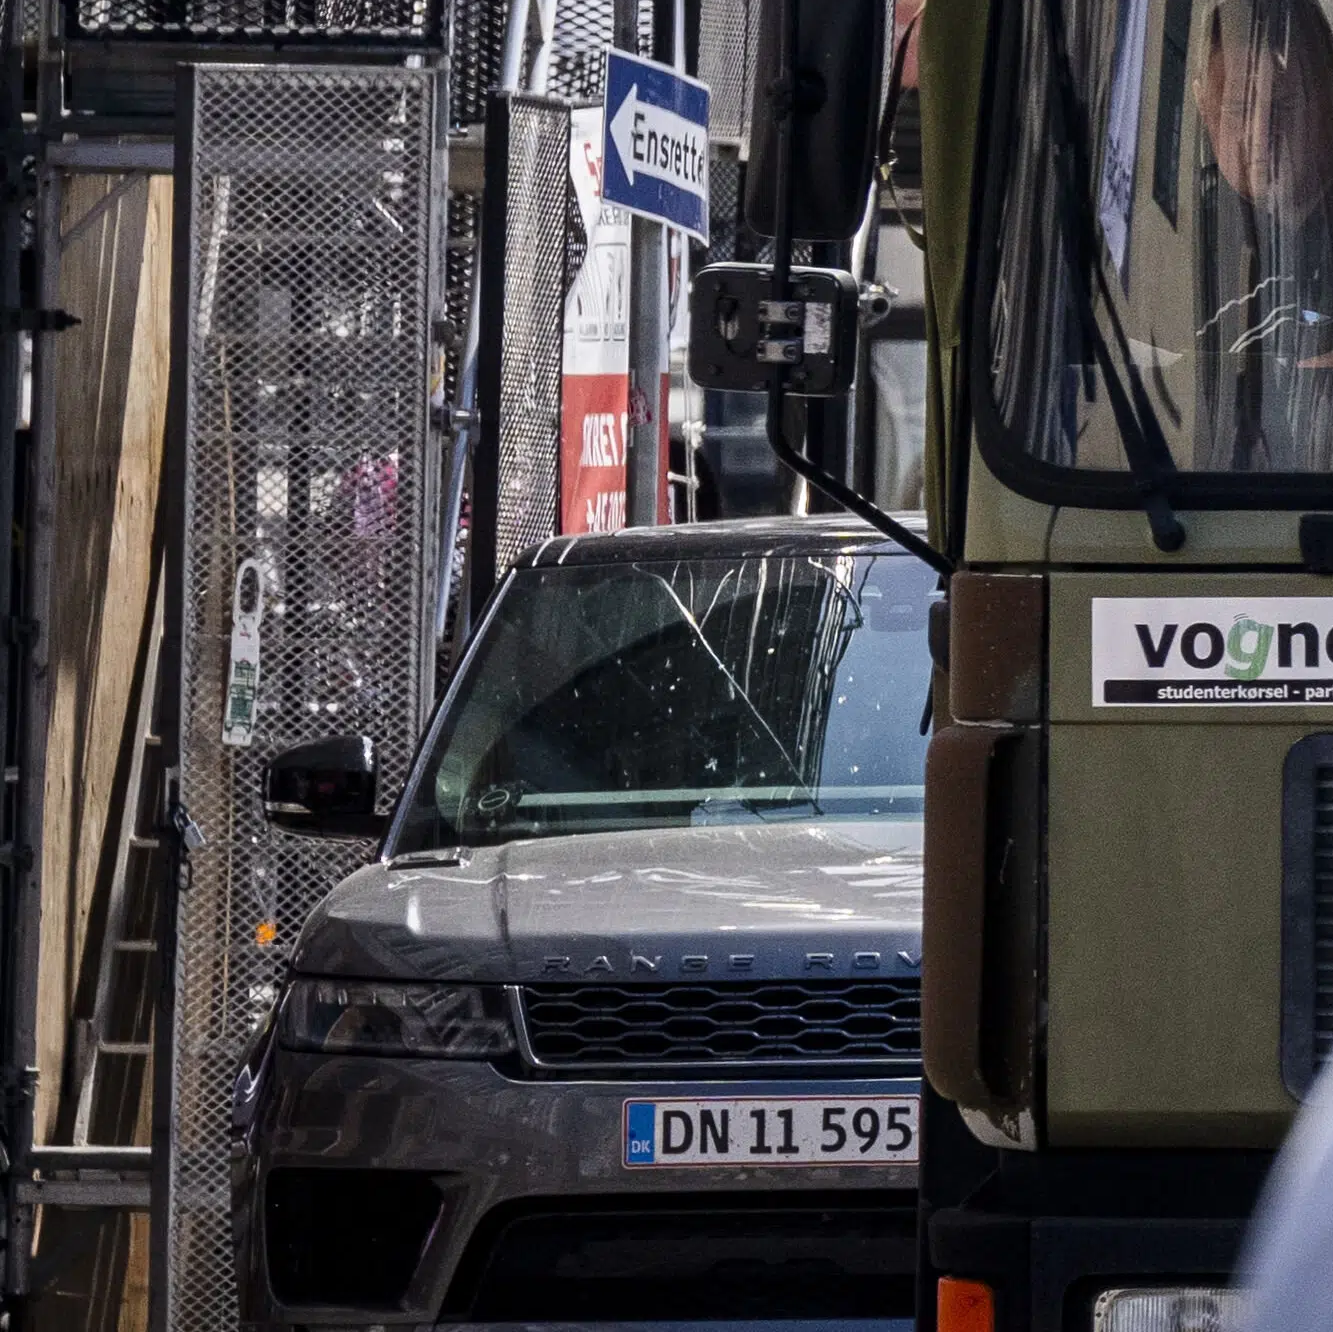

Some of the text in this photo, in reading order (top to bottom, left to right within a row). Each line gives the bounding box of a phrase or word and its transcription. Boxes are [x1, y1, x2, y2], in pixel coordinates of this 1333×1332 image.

[1157, 684, 1289, 700] studenterkørsel
[543, 950, 922, 974] RANGE ROV
[662, 1106, 913, 1155] DN 11 595
[631, 1139, 651, 1154] DK
